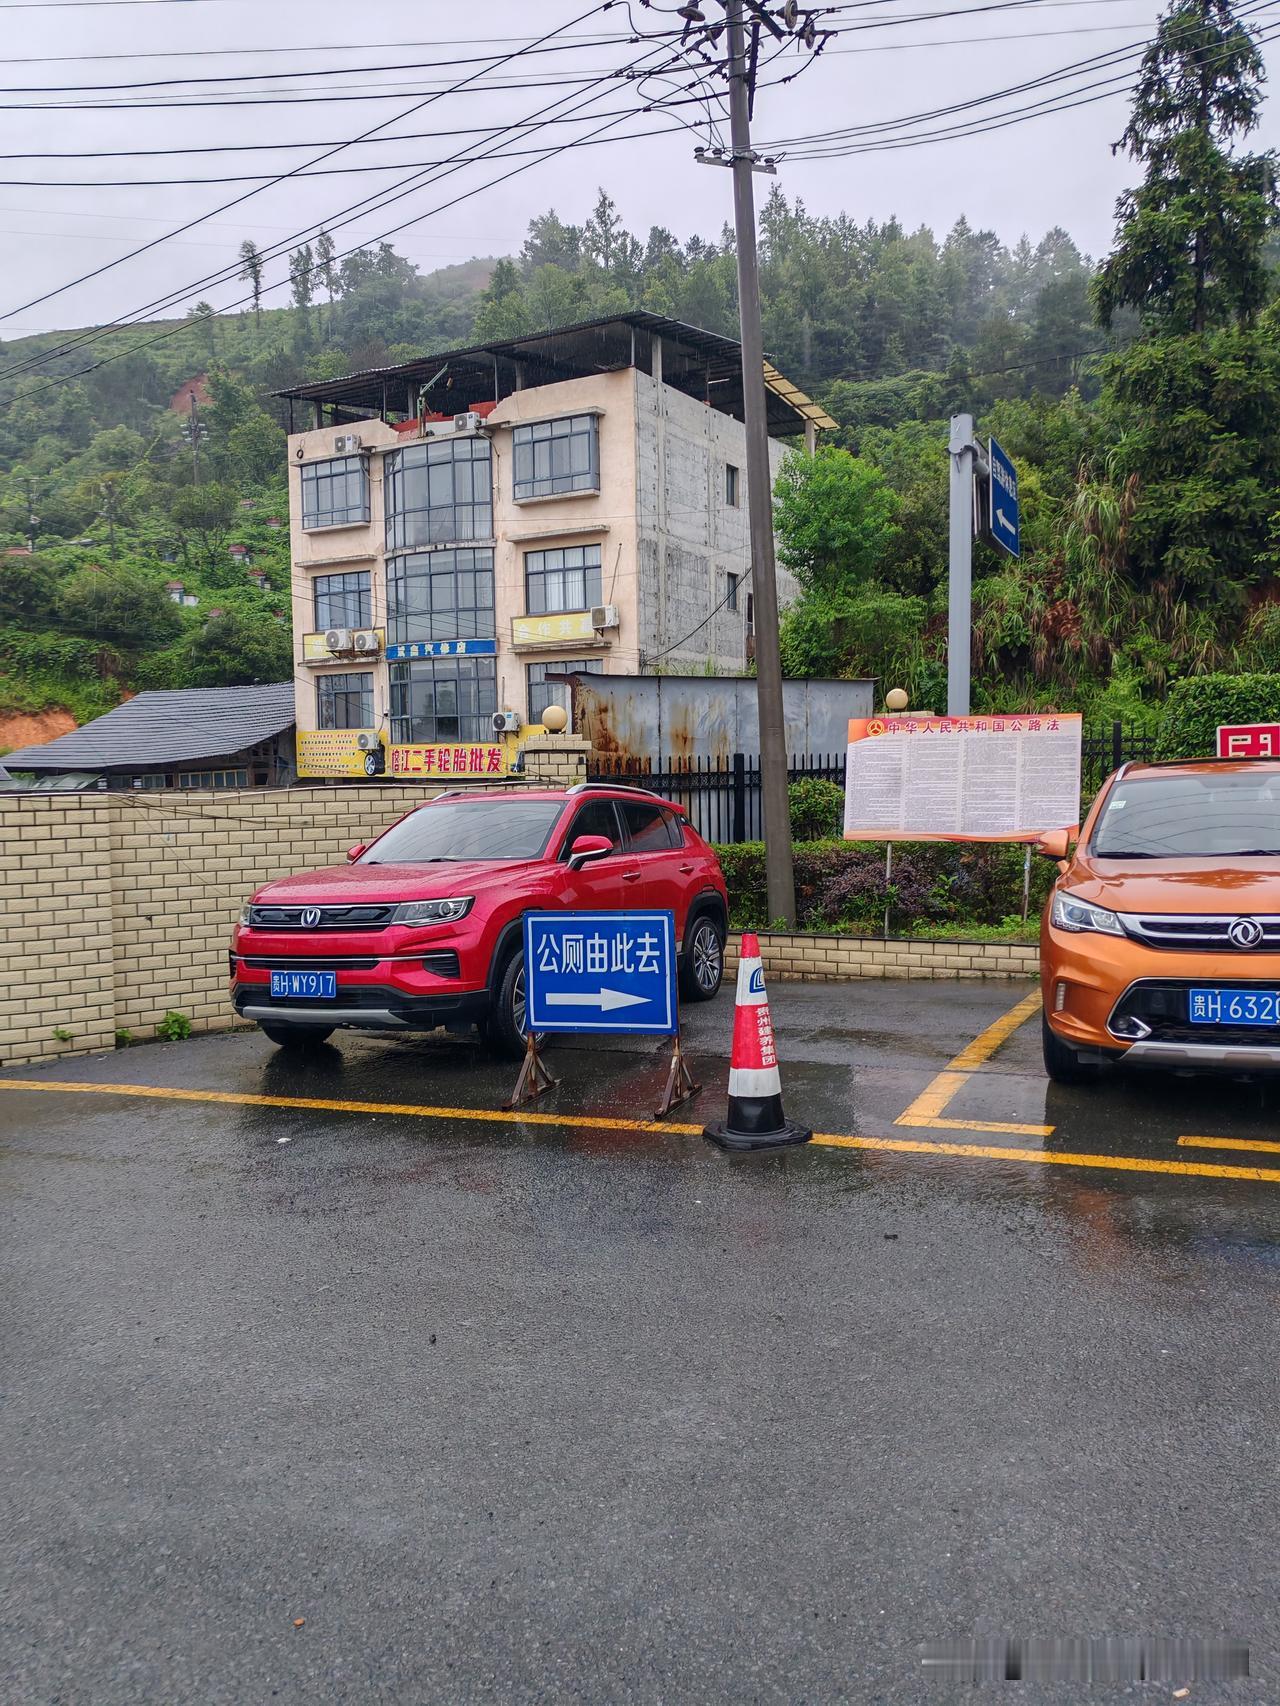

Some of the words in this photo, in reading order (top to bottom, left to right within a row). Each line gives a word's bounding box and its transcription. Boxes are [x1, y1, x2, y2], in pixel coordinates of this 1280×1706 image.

[887, 718, 1061, 735] 中华人民共和国公路法
[392, 747, 502, 772] 榕江二手轮胎批发
[537, 932, 660, 974] 公厕由此去
